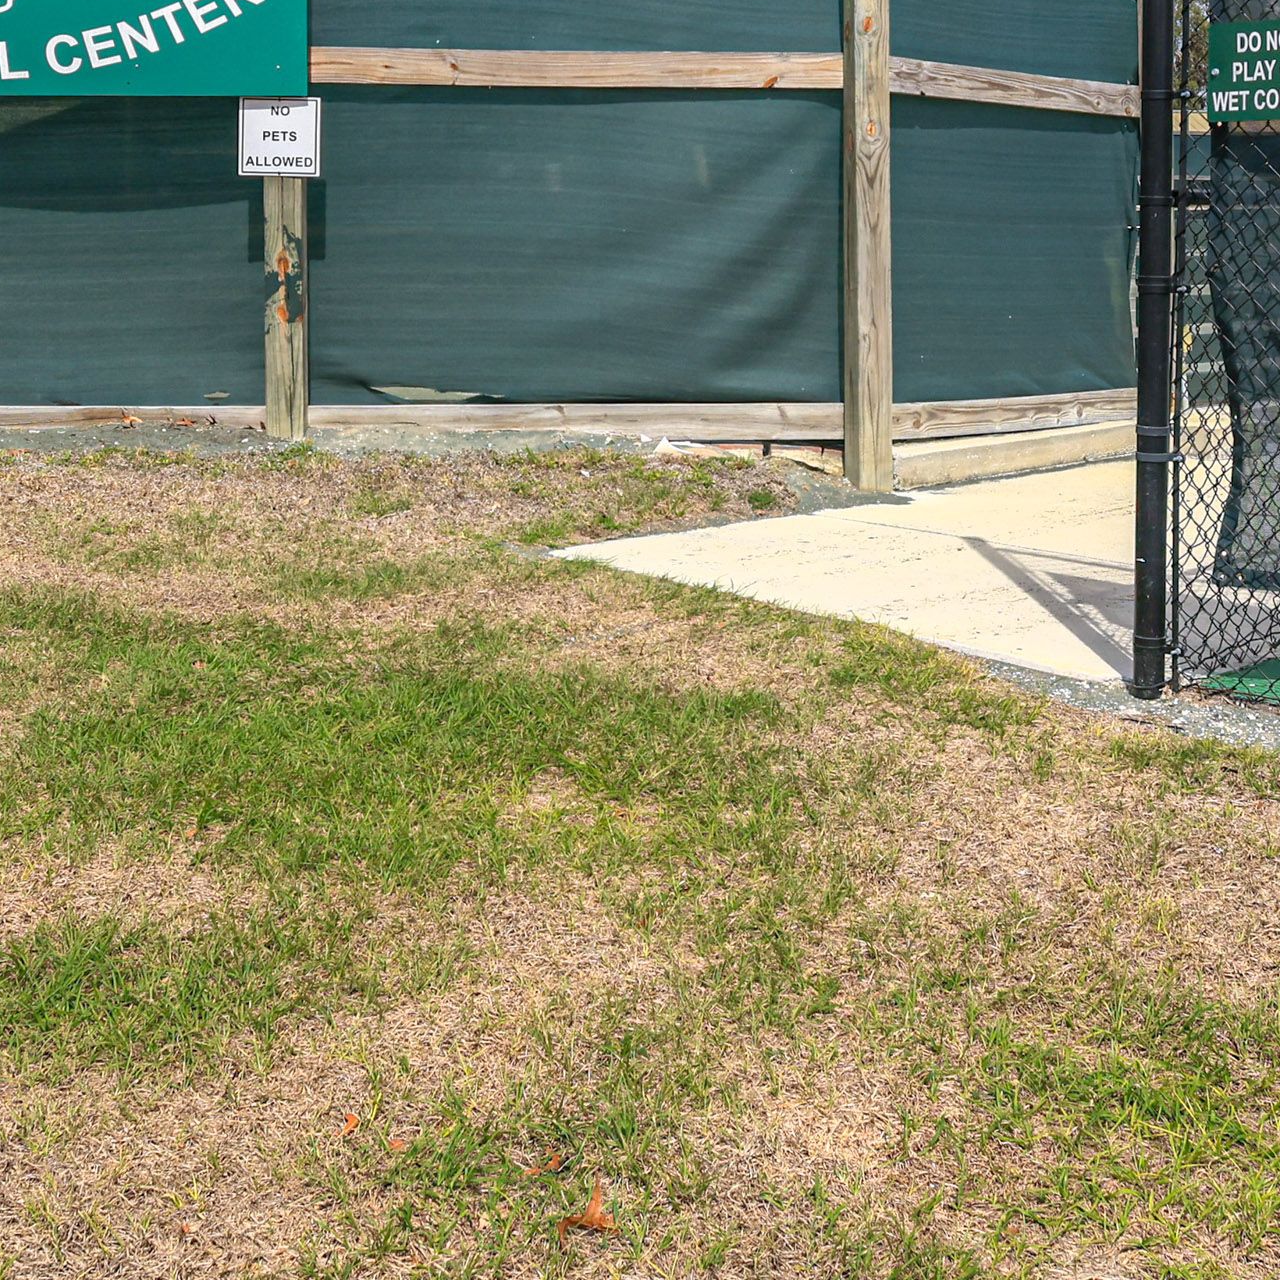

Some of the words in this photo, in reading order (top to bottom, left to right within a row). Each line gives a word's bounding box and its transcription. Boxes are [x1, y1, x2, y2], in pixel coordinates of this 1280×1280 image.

[1237, 31, 1261, 53] DO
[1232, 59, 1276, 82] PLAY
[1212, 91, 1249, 112] WET
[270, 106, 290, 116] NO
[262, 131, 297, 141] PETS
[245, 156, 313, 167] ALLOWED
